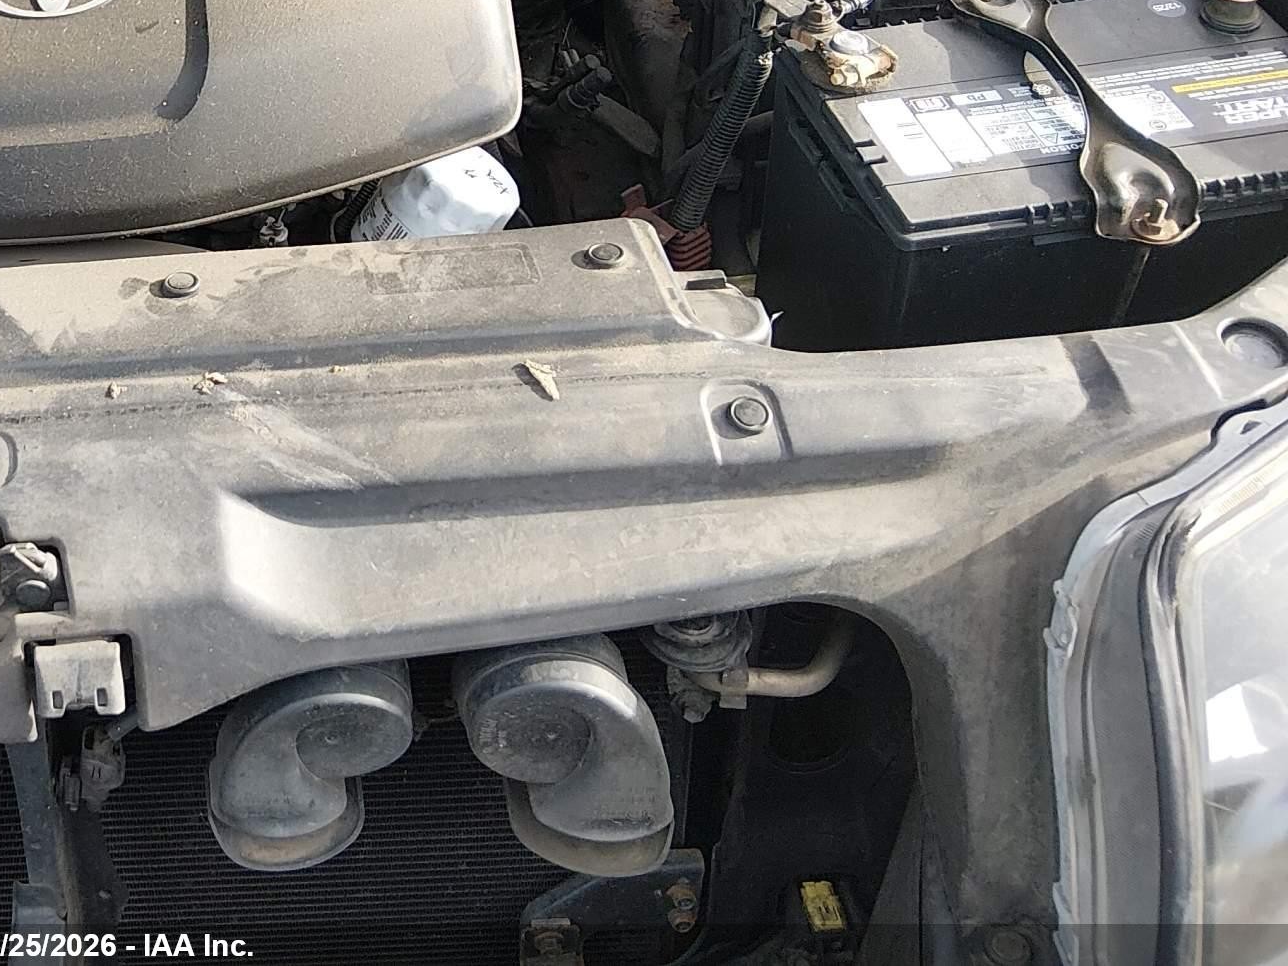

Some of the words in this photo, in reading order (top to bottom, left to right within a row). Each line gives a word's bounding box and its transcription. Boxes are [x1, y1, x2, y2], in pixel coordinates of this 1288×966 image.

[967, 93, 987, 101] Pb
[1223, 107, 1288, 124] UPER
[1040, 143, 1084, 154] OISON
